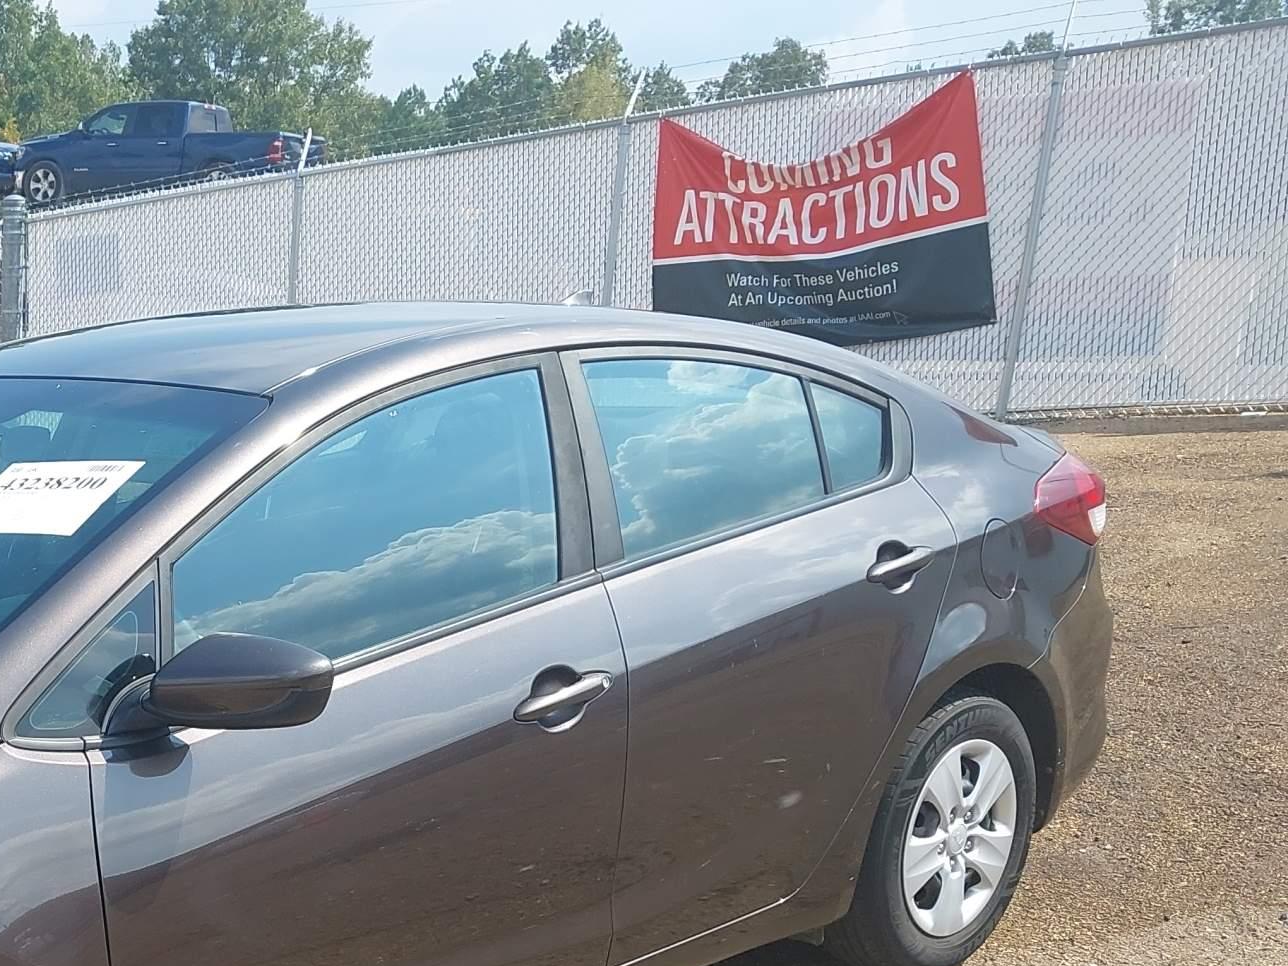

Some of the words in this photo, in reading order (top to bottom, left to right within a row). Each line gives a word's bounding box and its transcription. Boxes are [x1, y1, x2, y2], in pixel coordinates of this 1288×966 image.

[674, 152, 960, 245] ATTRACTIONS
[726, 272, 769, 288] Watch
[773, 274, 792, 288] For
[794, 273, 834, 288] These
[836, 261, 899, 283] Vehicles
[728, 292, 743, 307] At
[745, 292, 763, 306] An
[767, 292, 833, 307] Upcoming
[837, 279, 897, 303] Auction!
[781, 316, 805, 326] details
[807, 316, 821, 325] and
[822, 316, 848, 325] photos
[0, 476, 108, 490] 43238200
